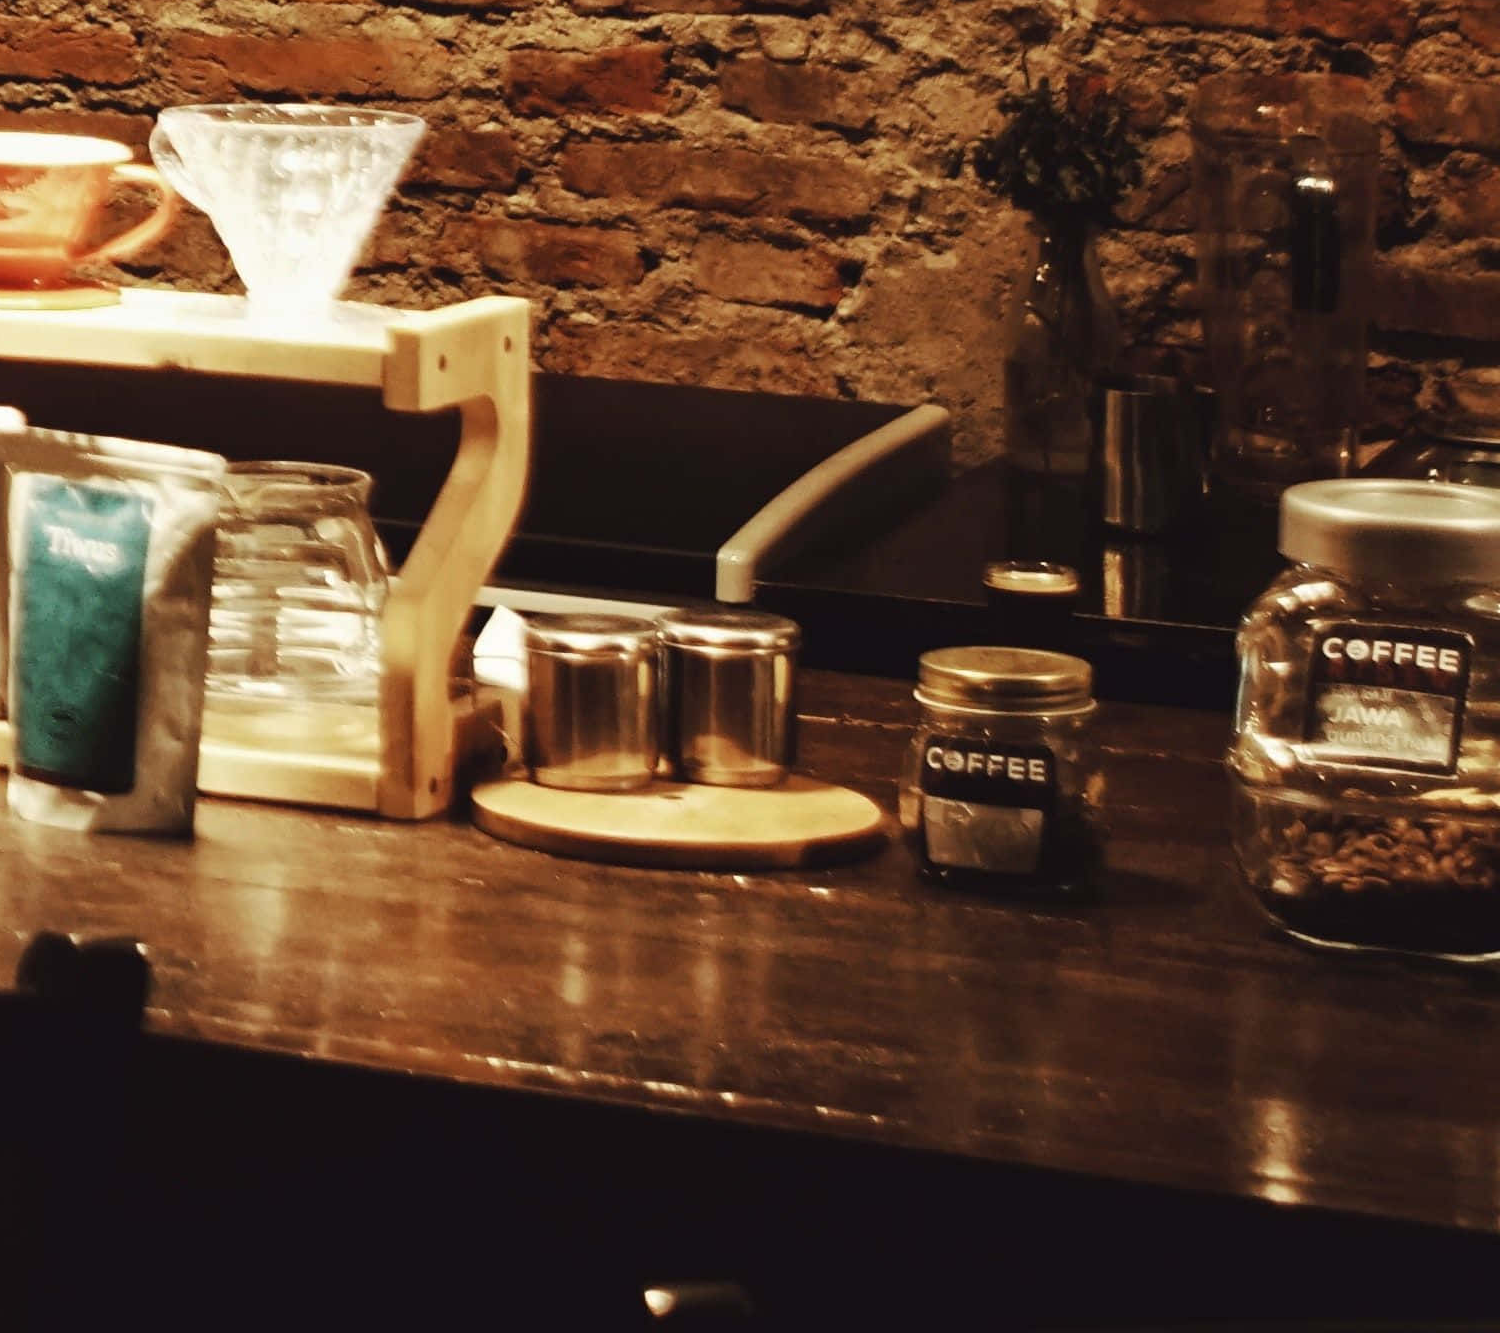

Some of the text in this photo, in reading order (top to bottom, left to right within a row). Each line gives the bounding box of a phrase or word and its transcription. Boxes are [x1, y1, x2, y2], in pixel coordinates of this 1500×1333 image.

[1321, 636, 1461, 674] COFFEE
[1328, 705, 1403, 729] JAWA
[926, 746, 1047, 782] COFFEE
